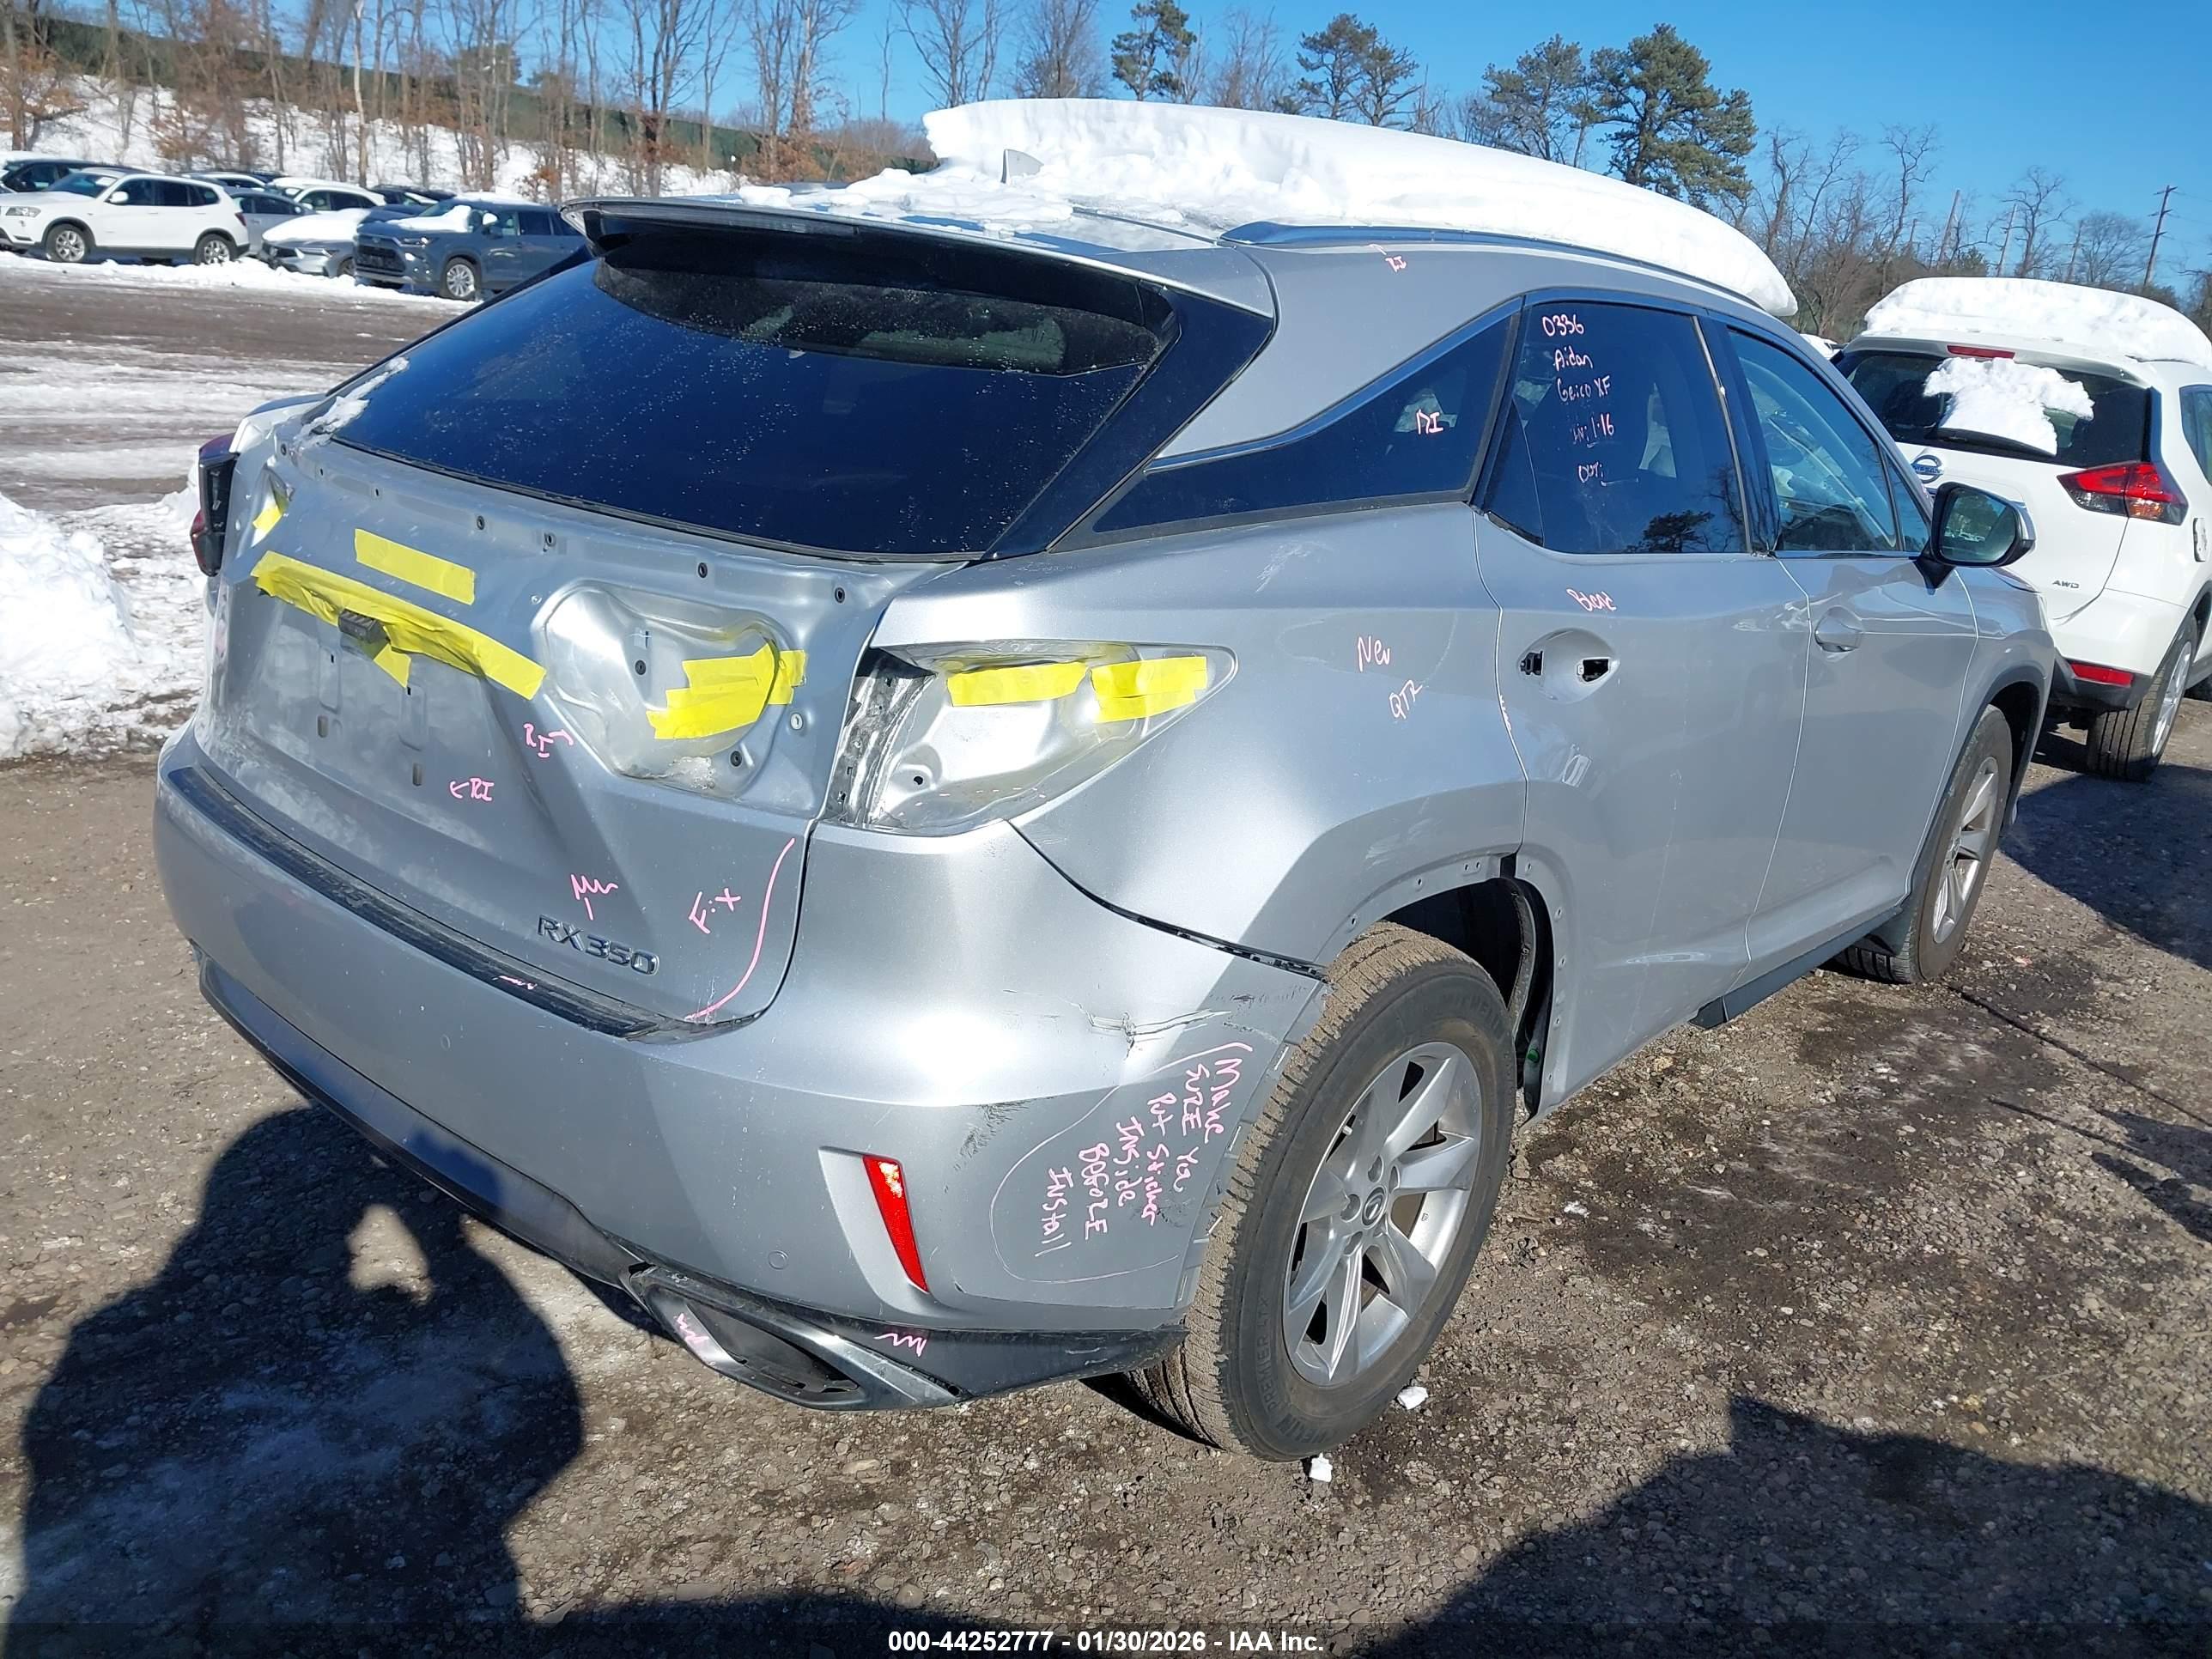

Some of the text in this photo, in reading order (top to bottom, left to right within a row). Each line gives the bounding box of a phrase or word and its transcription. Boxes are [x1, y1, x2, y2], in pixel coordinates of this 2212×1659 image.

[1541, 314, 1584, 337] 0336
[2052, 580, 2079, 589] AWD
[1257, 1338, 1279, 1412] PREMIER
